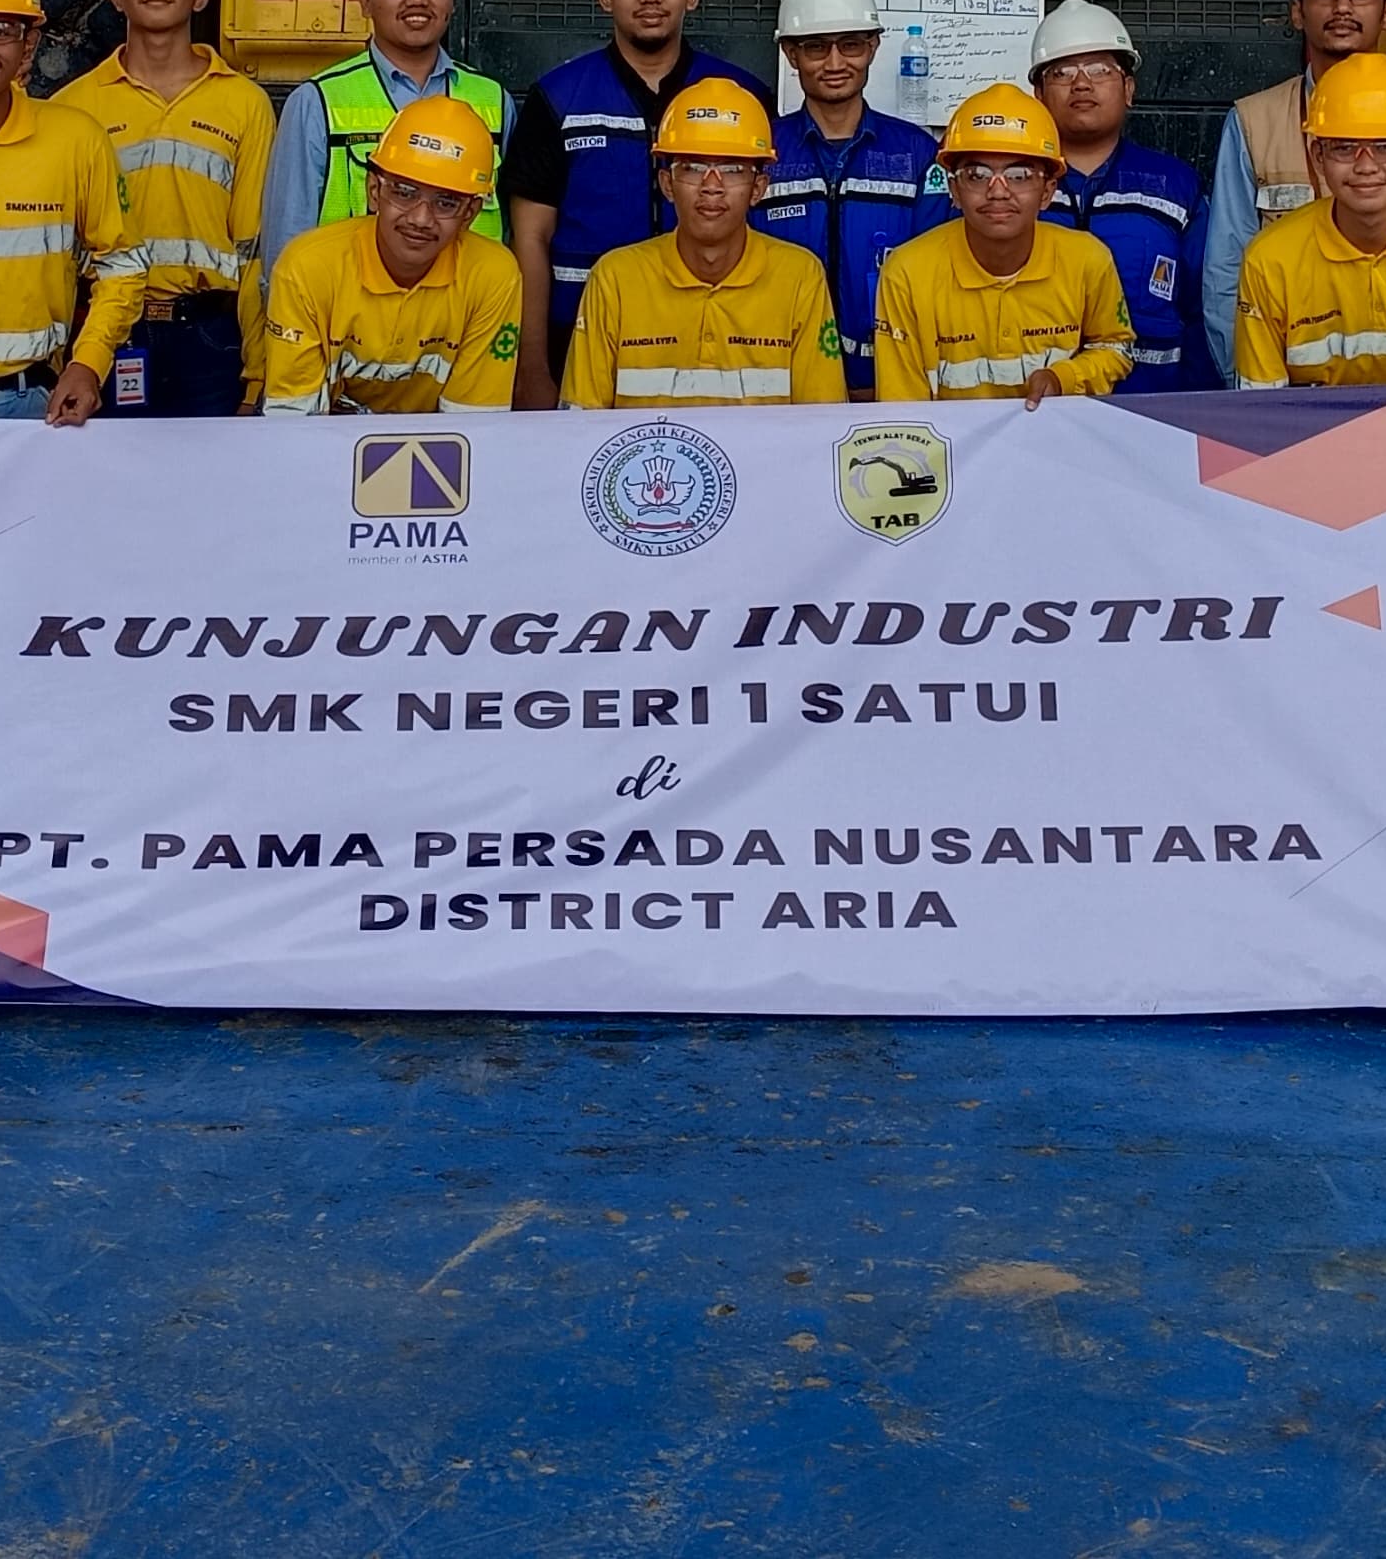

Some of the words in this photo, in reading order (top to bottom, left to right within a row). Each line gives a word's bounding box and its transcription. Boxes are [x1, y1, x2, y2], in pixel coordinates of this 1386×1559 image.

[566, 137, 605, 149] VISITOR
[121, 378, 139, 392] 22
[853, 433, 881, 447] TEKNIK
[906, 433, 932, 446] BERAT
[585, 465, 604, 524] SEKOLAH
[597, 426, 666, 465] MENENGAH
[670, 427, 728, 470] KEJURUAN
[720, 470, 734, 520] NEGERI
[349, 521, 469, 549] PAMA
[870, 513, 920, 529] TAB
[614, 534, 654, 555] SMKN
[666, 533, 707, 556] SATUI
[348, 554, 400, 565] member
[404, 554, 417, 564] of
[422, 553, 469, 564] ASTRA
[19, 609, 711, 659] KUNJUNGAN
[733, 596, 1285, 649] INDUSTRI
[168, 692, 364, 733] SMK
[396, 685, 709, 732] NEGERI
[740, 682, 768, 724] 1
[800, 681, 1058, 724] SATUI
[616, 754, 682, 801] di
[141, 831, 385, 870] PAMA
[413, 829, 786, 869] PERSADA
[814, 823, 1322, 866] NUSANTARA
[359, 892, 735, 931] DISTRICT
[761, 891, 958, 929] ARIA
